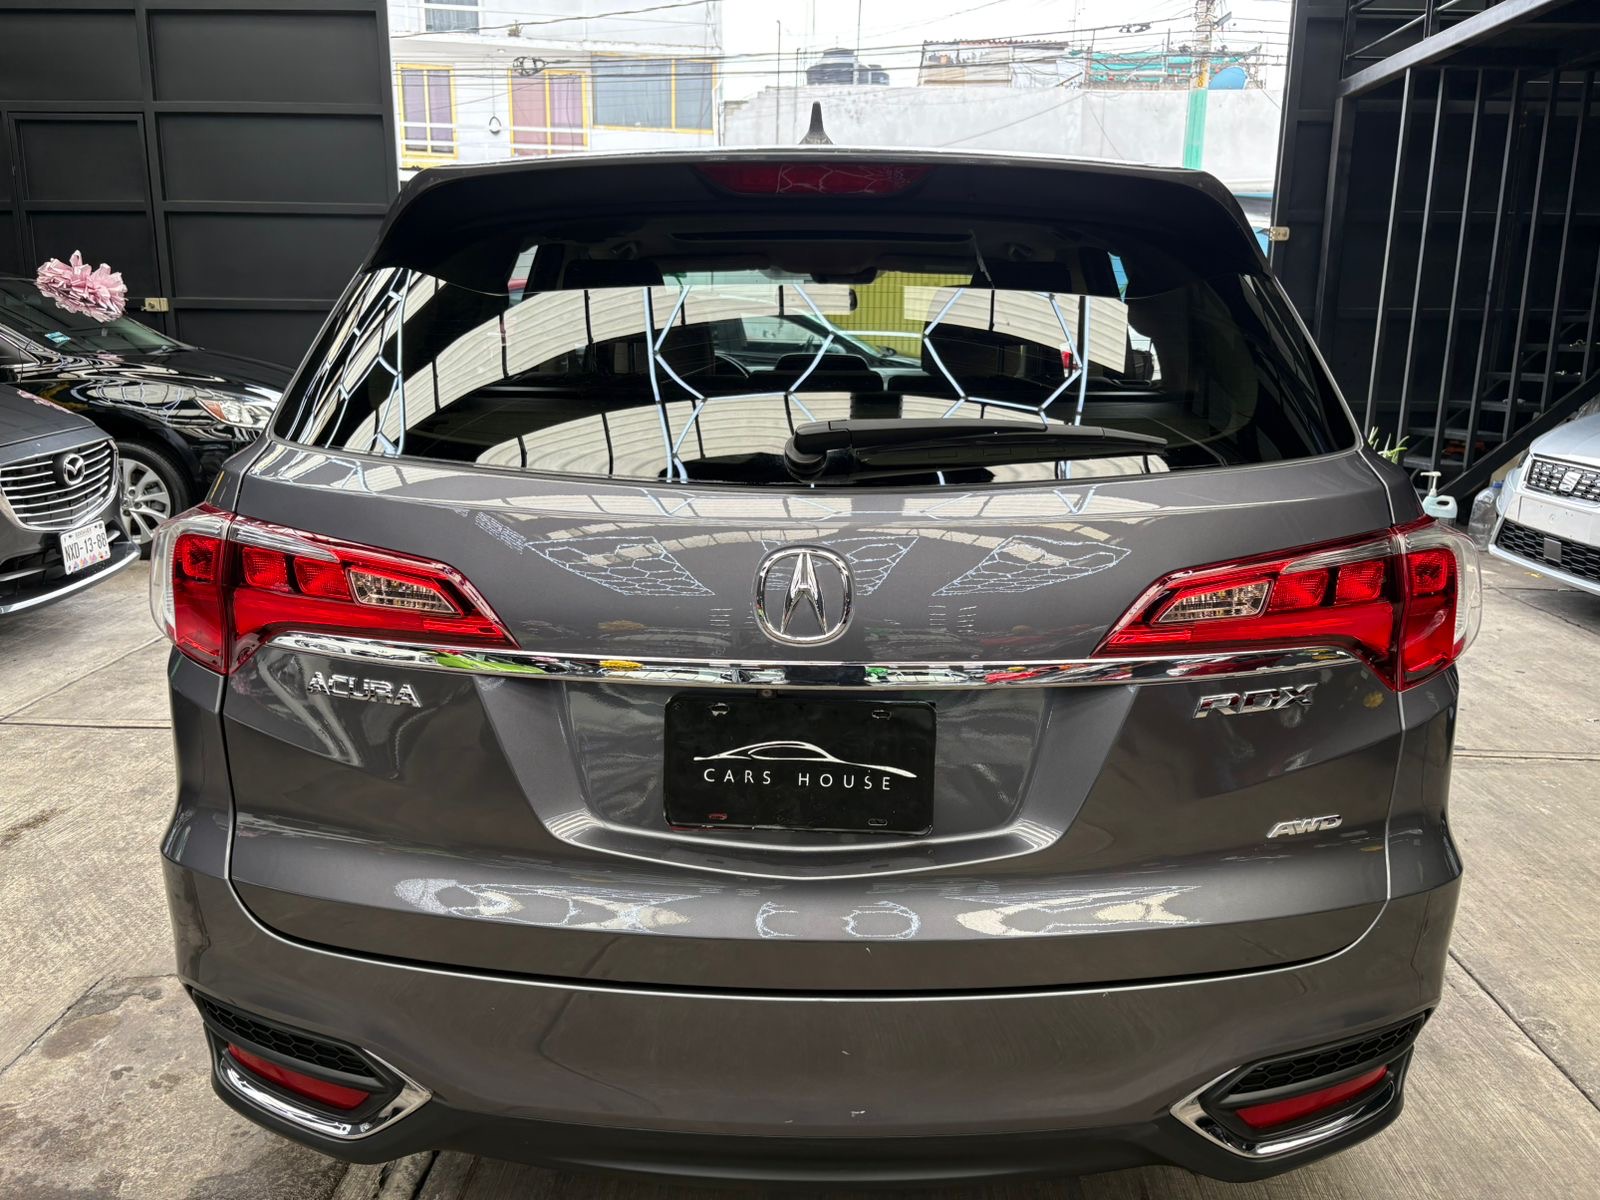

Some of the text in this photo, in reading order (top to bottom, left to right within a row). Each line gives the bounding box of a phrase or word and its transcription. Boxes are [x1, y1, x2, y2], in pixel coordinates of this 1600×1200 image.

[307, 671, 422, 708] ACURA
[1193, 682, 1318, 719] RDX
[703, 768, 891, 790] CARS HOUSE
[1266, 814, 1342, 839] AWD
